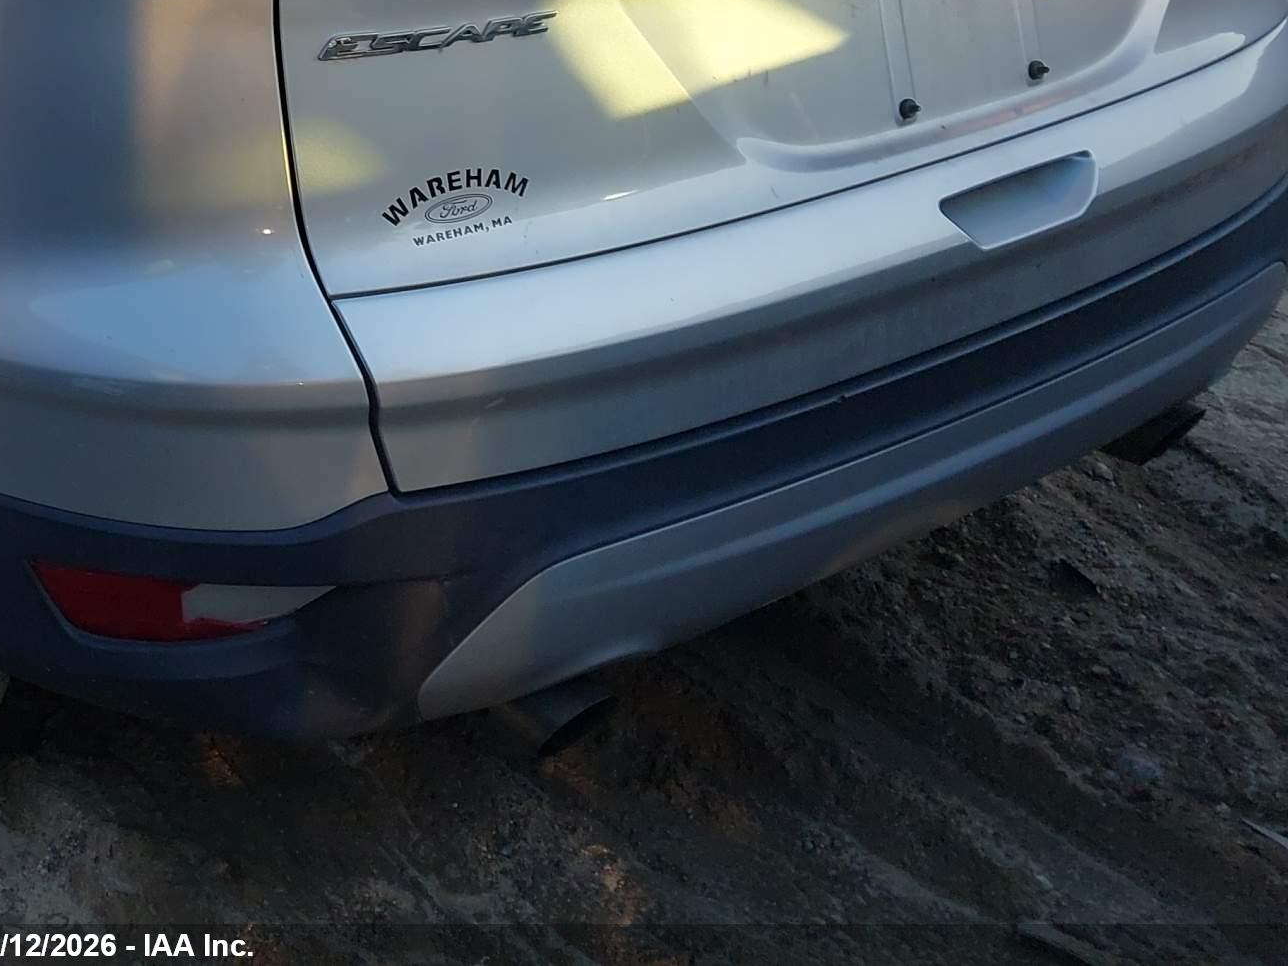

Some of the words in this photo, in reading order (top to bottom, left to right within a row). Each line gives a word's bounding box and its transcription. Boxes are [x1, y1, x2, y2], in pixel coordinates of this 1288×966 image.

[318, 10, 558, 61] ESCAPE
[381, 168, 529, 227] WAREHAM
[439, 200, 480, 219] Ford
[413, 222, 490, 247] WAREHAM,
[492, 215, 513, 229] MA
